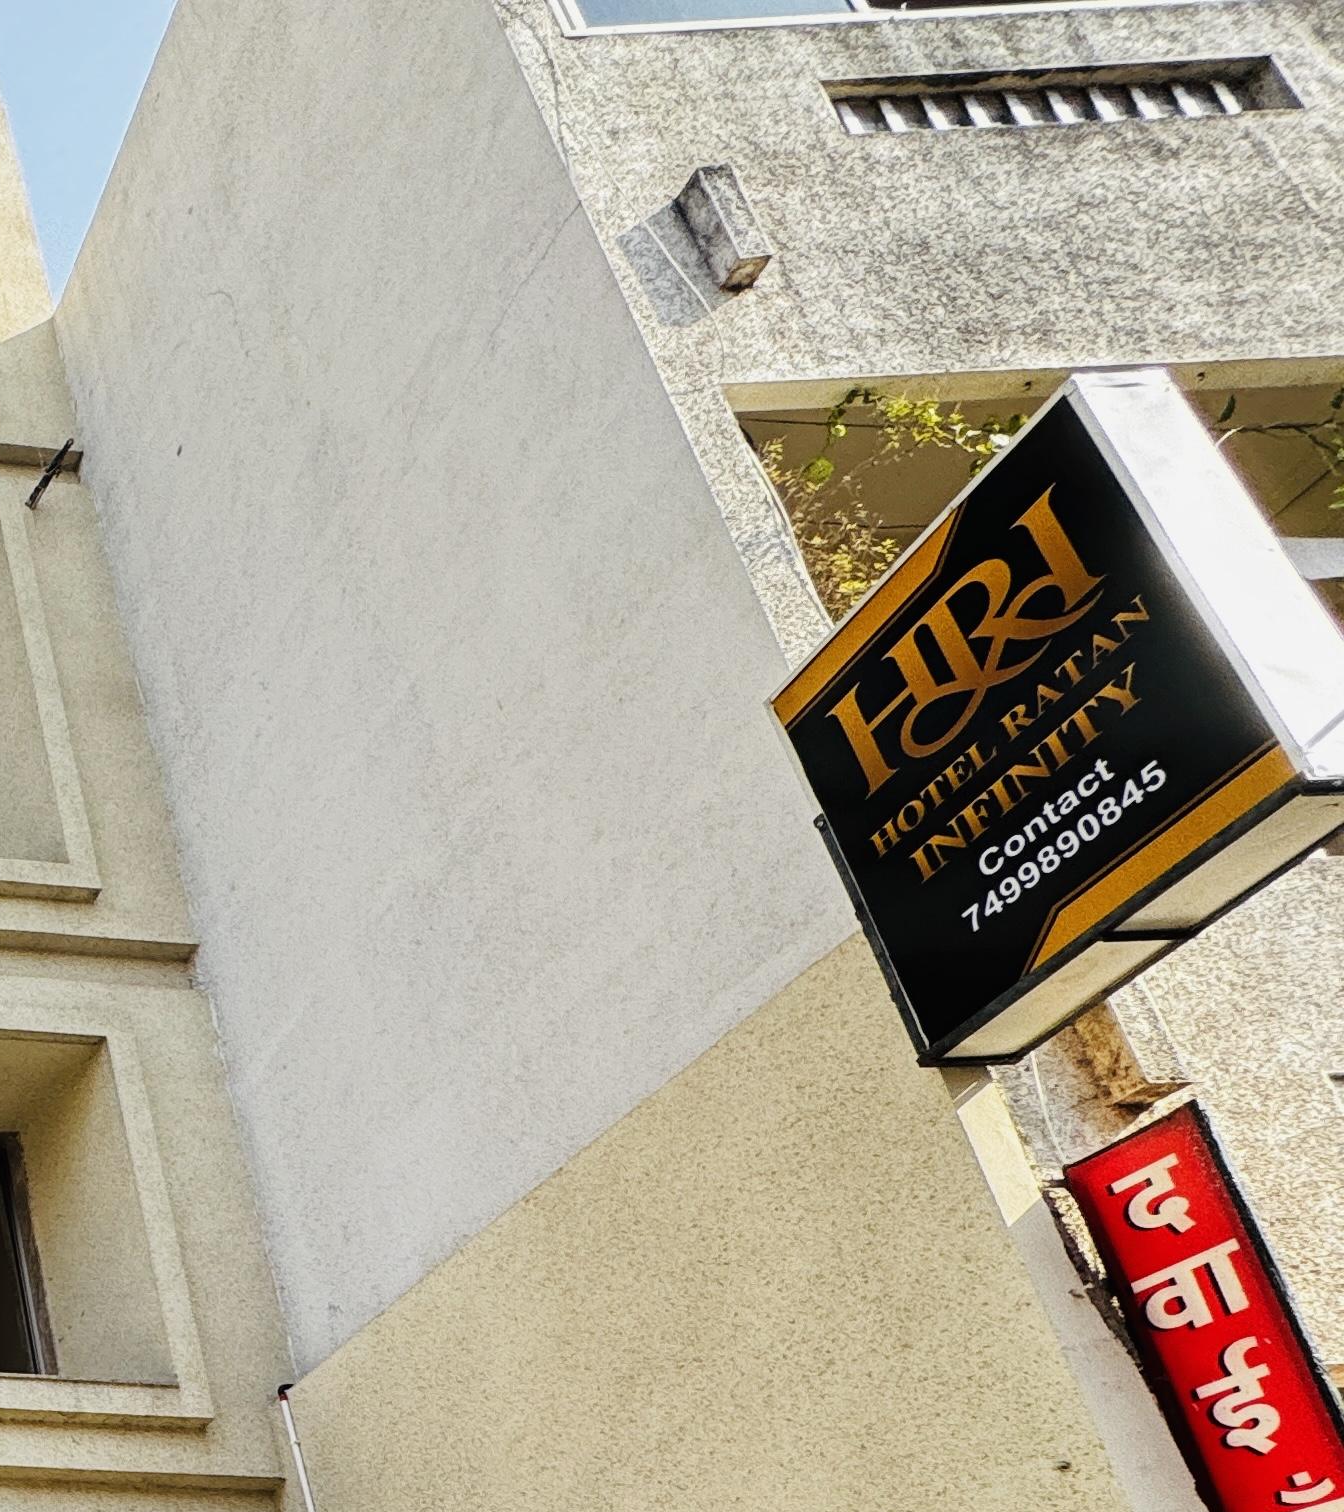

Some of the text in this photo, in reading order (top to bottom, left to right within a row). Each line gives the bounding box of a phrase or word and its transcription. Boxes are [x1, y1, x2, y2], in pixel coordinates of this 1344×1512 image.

[870, 594, 1151, 858] HOTEL RATAN
[909, 662, 1143, 884] INFINITY
[978, 758, 1116, 875] Contact
[961, 760, 1167, 932] 7499890845
